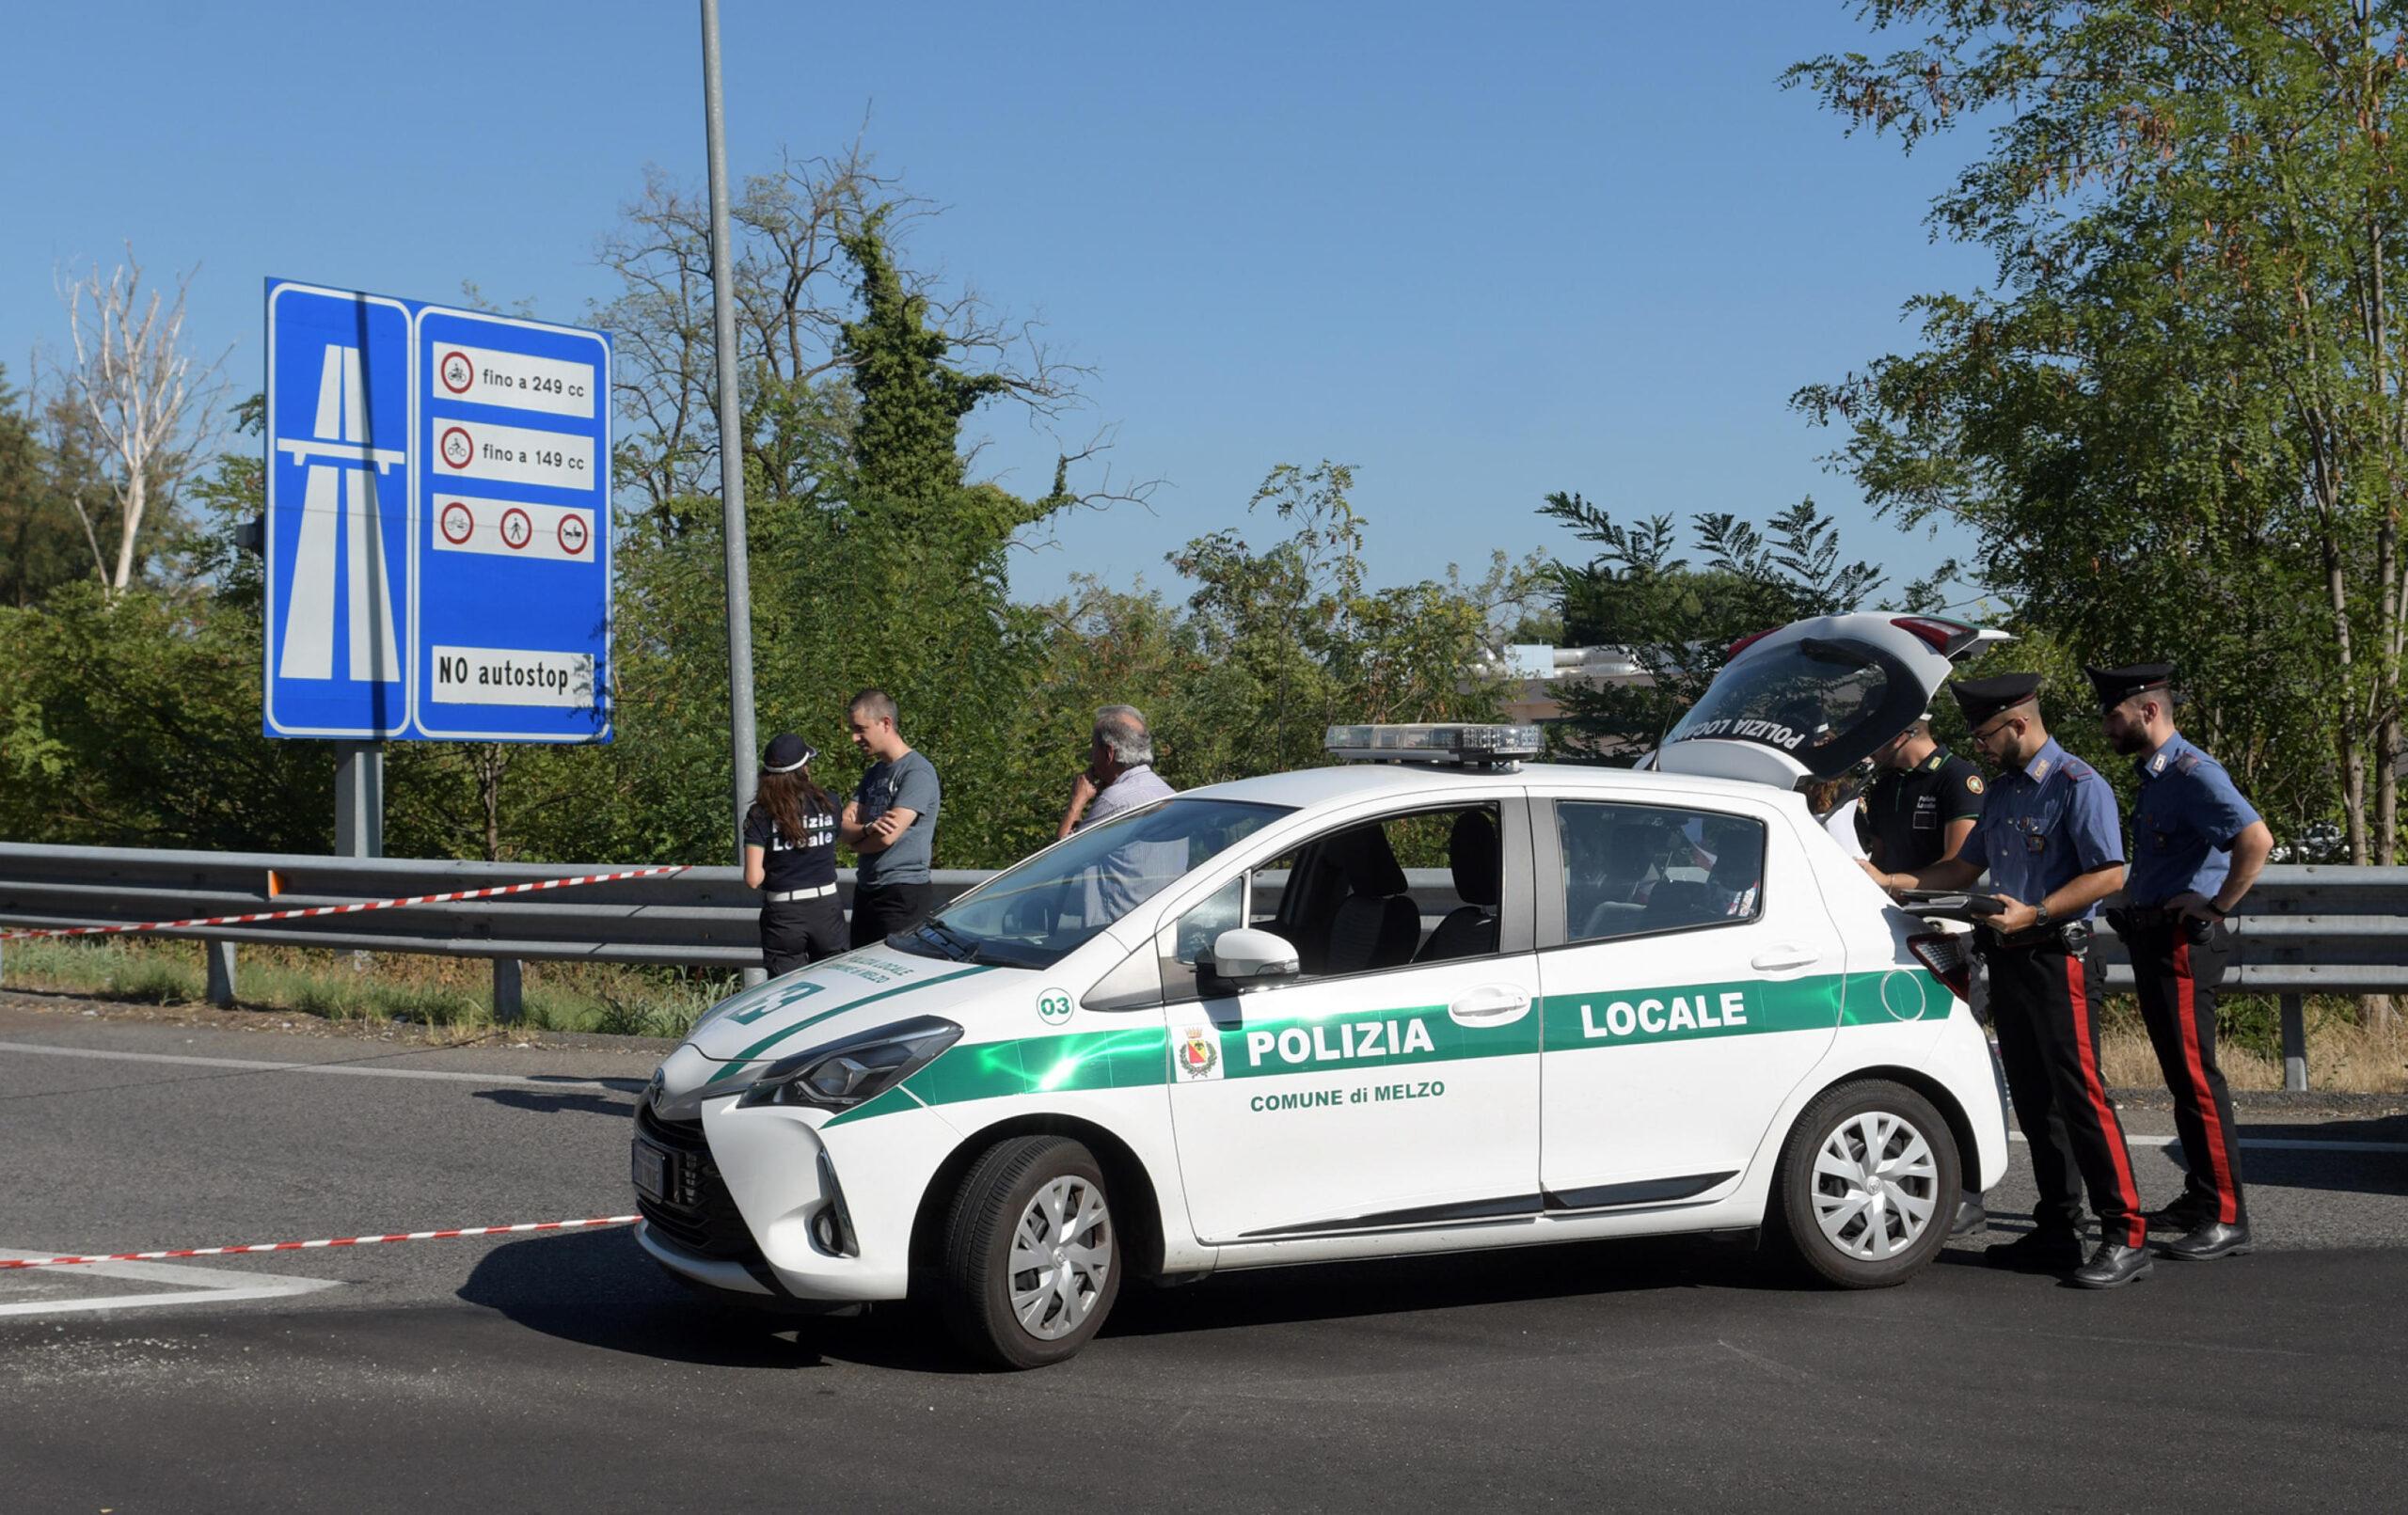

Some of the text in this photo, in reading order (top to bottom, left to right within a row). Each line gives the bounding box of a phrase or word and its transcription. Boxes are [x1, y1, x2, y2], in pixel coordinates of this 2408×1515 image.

[483, 369, 584, 397] fino a 249 cc
[483, 443, 584, 470] fino a 149 cc
[439, 656, 568, 695] NO autostop
[1732, 718, 1806, 750] POLIZIA
[772, 813, 833, 833] izia
[1040, 997, 1069, 1016] 03
[1246, 992, 1747, 1066] POLIZIA LOCALE
[1250, 1081, 1445, 1112] COMUNE di MELZO
